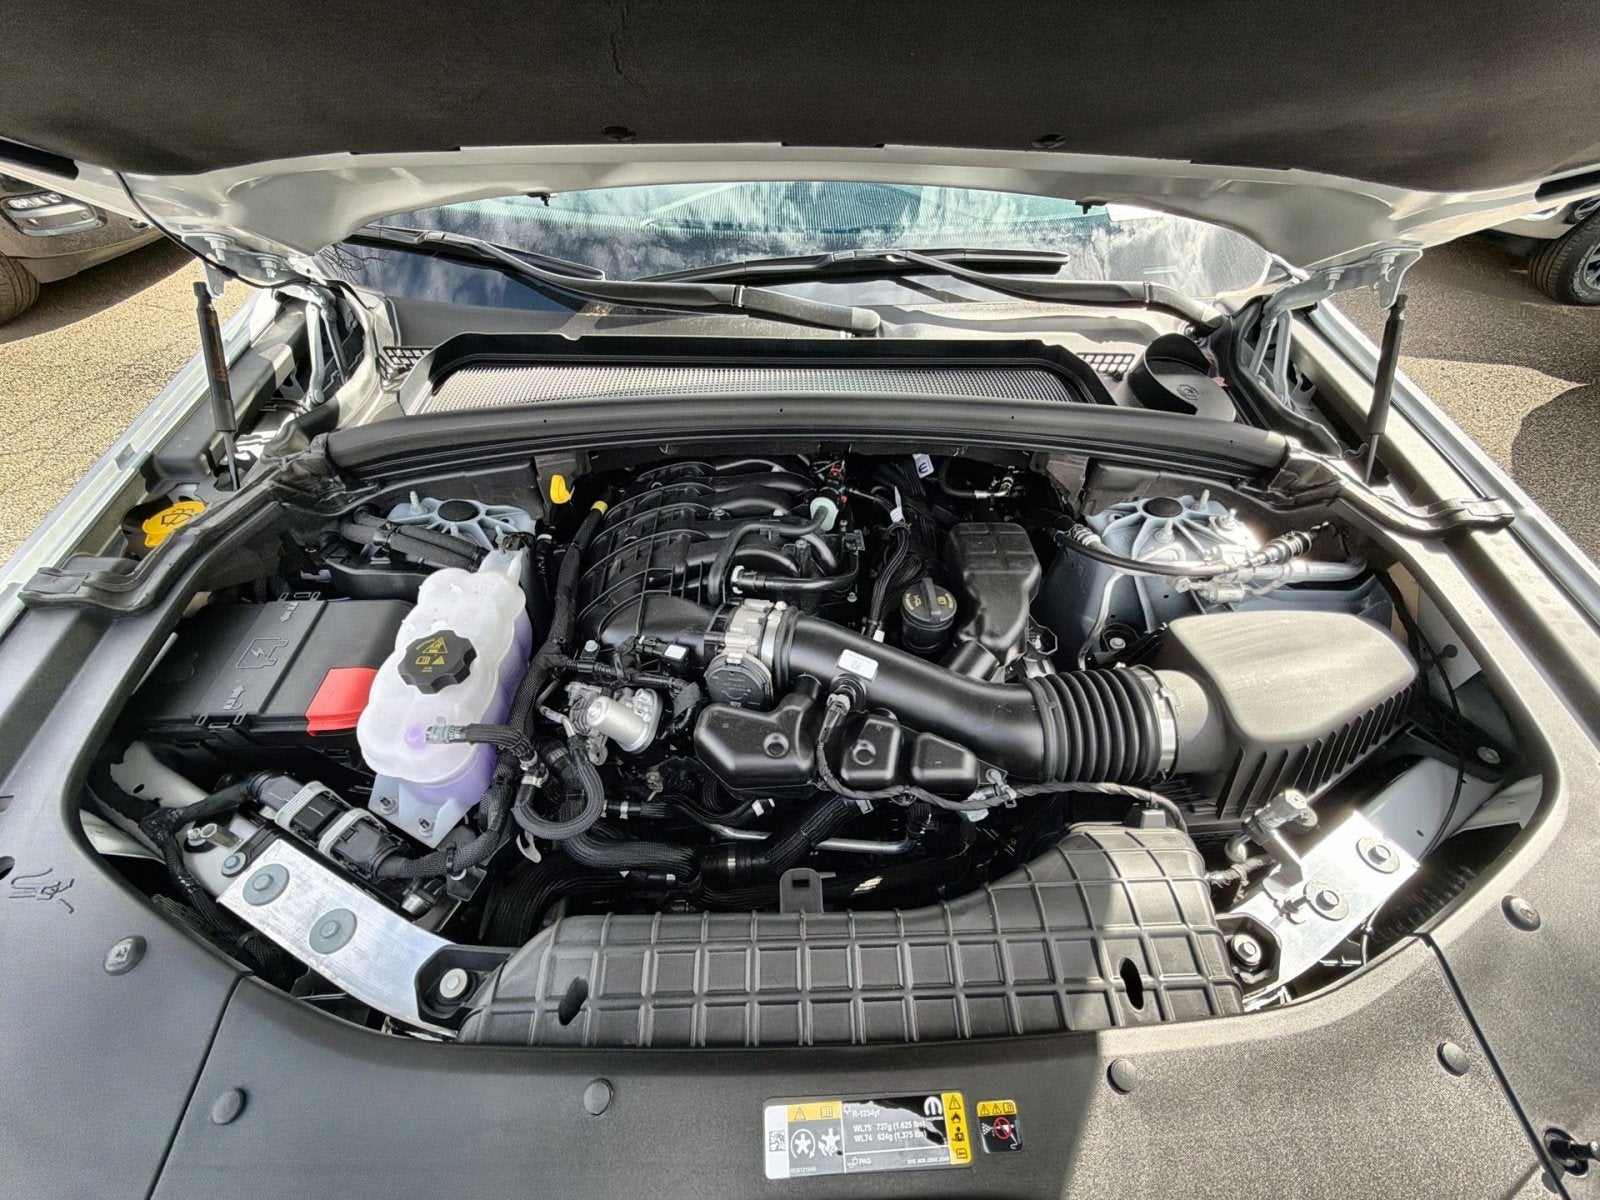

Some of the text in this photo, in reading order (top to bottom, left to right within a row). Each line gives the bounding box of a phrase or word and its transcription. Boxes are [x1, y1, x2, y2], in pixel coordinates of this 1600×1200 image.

[852, 1109, 881, 1118] R-1234yf
[853, 1124, 872, 1133] WL75
[876, 1123, 892, 1132] 737g
[893, 1121, 912, 1131] (1.625
[854, 1133, 873, 1142] WL74
[894, 1131, 913, 1141] (1.375
